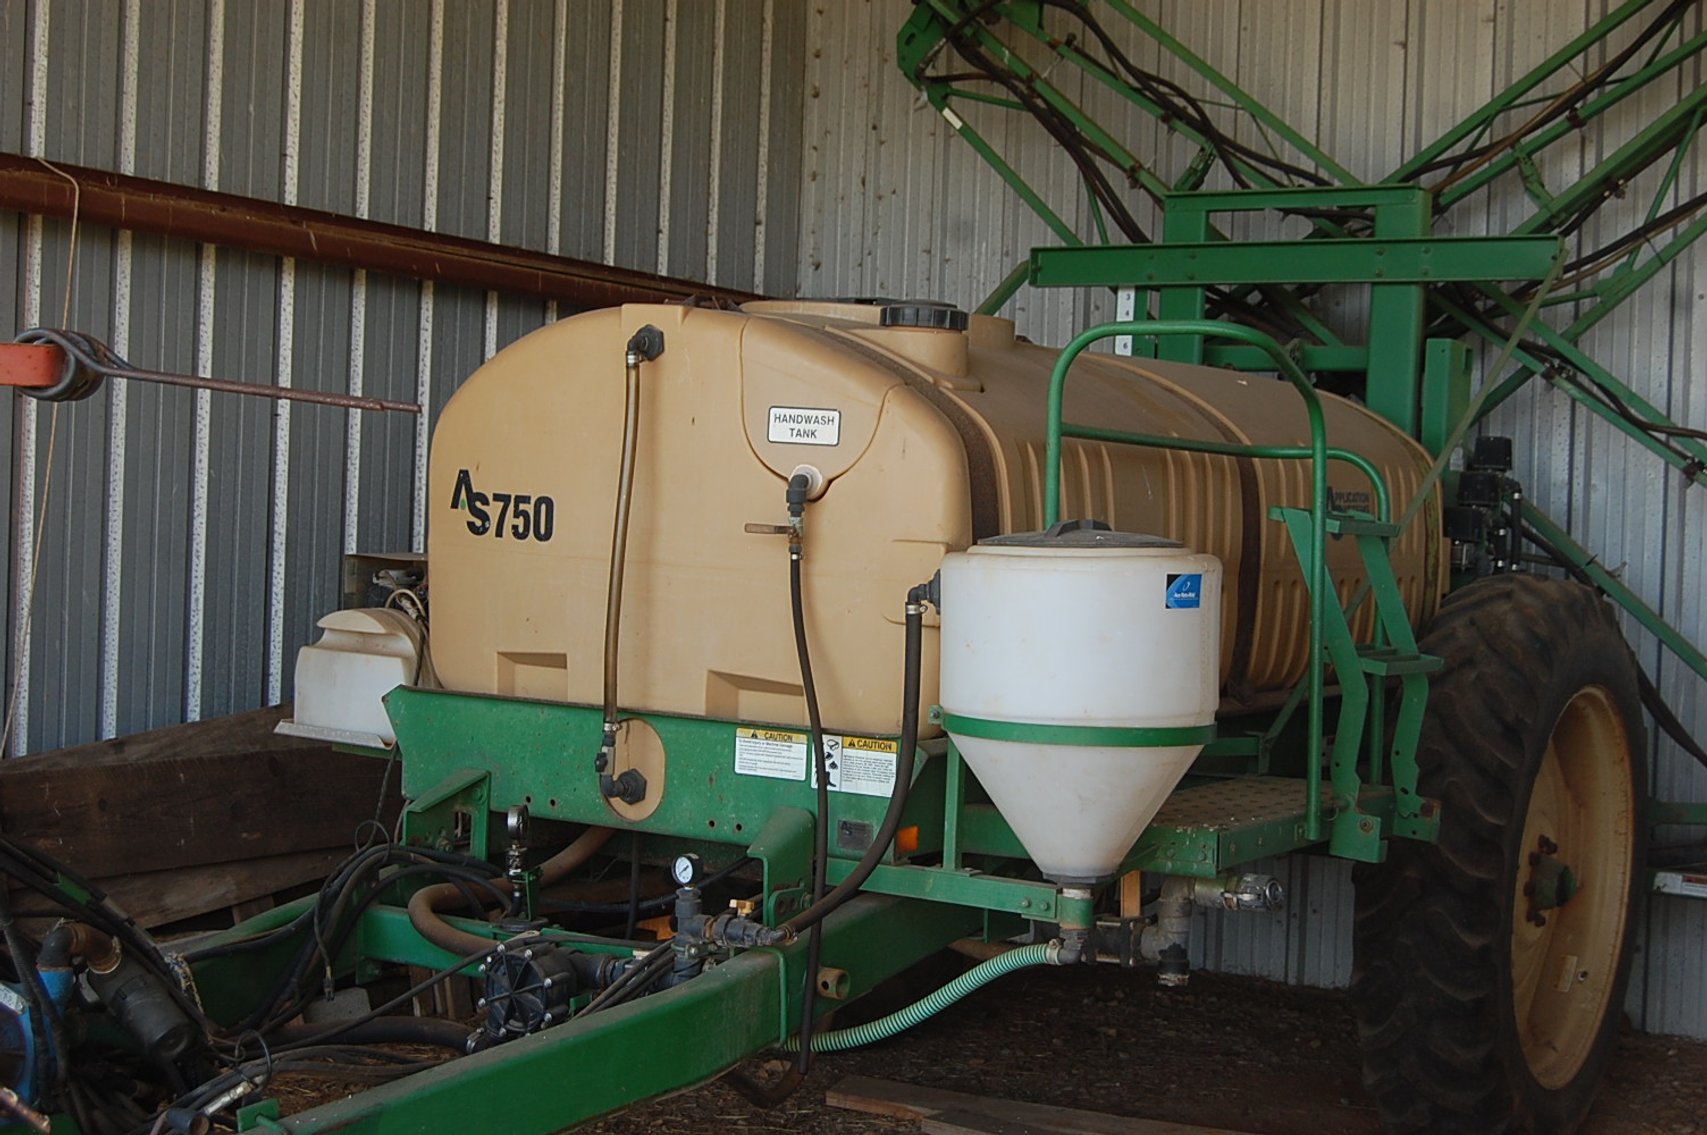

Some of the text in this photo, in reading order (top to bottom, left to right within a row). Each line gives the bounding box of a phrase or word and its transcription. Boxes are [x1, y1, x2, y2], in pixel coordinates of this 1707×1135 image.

[1126, 293, 1131, 301] 3
[773, 413, 835, 426] HANDWASH
[789, 428, 817, 439] TANK
[764, 732, 793, 742] CAUTION
[856, 739, 892, 750] CAUTION
